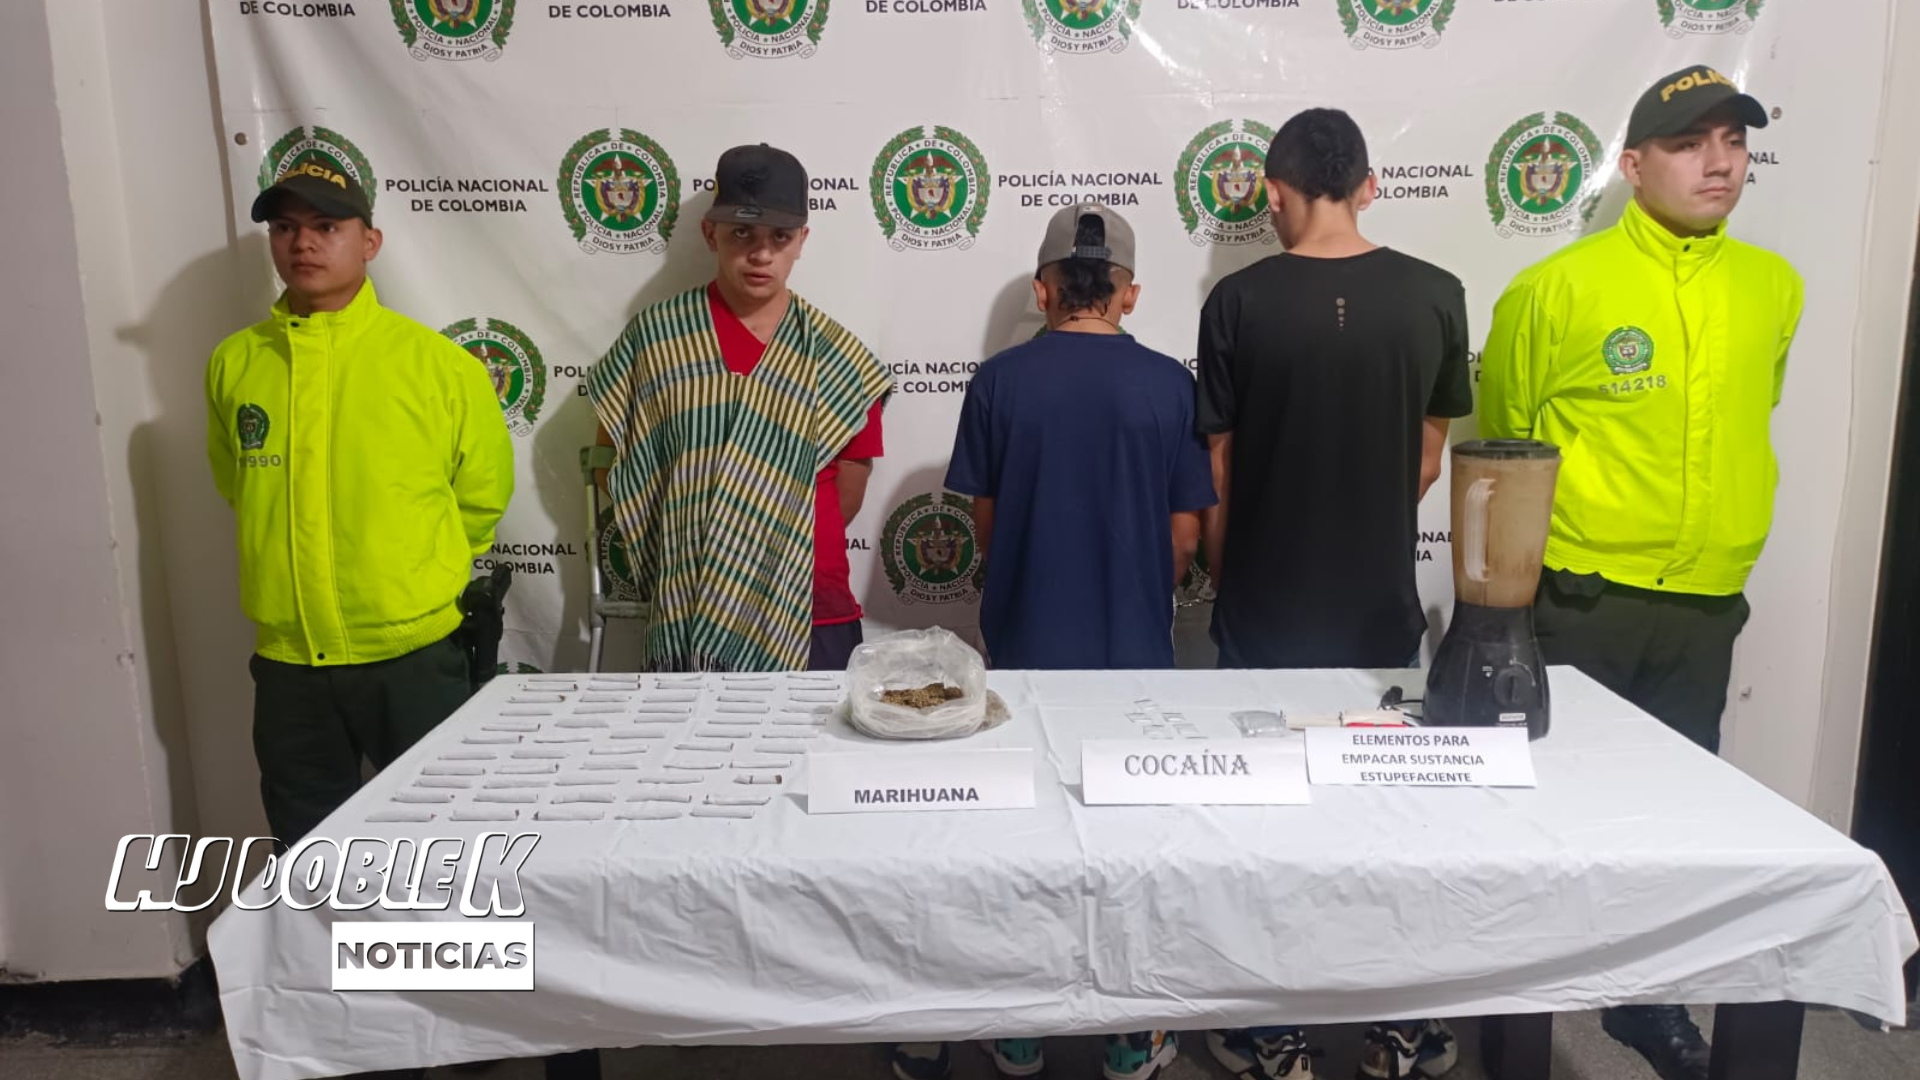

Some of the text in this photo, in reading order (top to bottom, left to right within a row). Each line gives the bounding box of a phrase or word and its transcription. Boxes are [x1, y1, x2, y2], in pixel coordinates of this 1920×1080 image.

[240, 1, 356, 17] DE COLOMBIA
[549, 4, 671, 18] DE COLOMBIA
[866, 0, 987, 13] DE COLOMBIA
[1041, 8, 1071, 36] POLICIA
[1355, 2, 1438, 33] POLICIA NACIONAL
[412, 15, 498, 45] POLICIA NACIONAL
[730, 12, 812, 42] POLICIA NACIONAL
[456, 44, 488, 57] PATRIA
[772, 40, 803, 55] PATRIA
[1082, 35, 1114, 50] PATRIA
[1190, 139, 1222, 191] REPUBLICA
[1500, 132, 1533, 183] REPUBLICA
[574, 148, 601, 198] REPUBLICA
[635, 149, 665, 198] COLOMBIA
[886, 146, 914, 196] REPUBLICA
[947, 145, 975, 195] COLOMBIA
[998, 170, 1163, 187] POLICÍA NACIONAL
[1382, 164, 1474, 179] NACIONAL
[385, 176, 548, 193] POLICÍA NACIONAL
[411, 199, 527, 212] DE COLOMBIA
[1021, 194, 1043, 207] DE
[1502, 194, 1530, 220] POLICIA
[581, 210, 663, 239] POLICIA NACIONAL
[891, 206, 972, 235] POLICIA NACIONAL
[1195, 203, 1224, 229] POLICIA
[931, 233, 962, 247] PATRIA
[1236, 227, 1266, 242] PATRIA
[624, 236, 654, 251] PATRIA
[501, 337, 531, 383] COLOMBIA
[491, 543, 577, 556] NACIONAL
[901, 566, 929, 590] POLICIA
[1352, 734, 1470, 746] ELEMENTOS PARA
[1124, 749, 1250, 776] COCAÍNA
[1342, 753, 1485, 766] EMPACAR SUSTANCIA
[1360, 771, 1472, 782] ESTUPEFACIENTE
[854, 787, 979, 804] MARIHUANA
